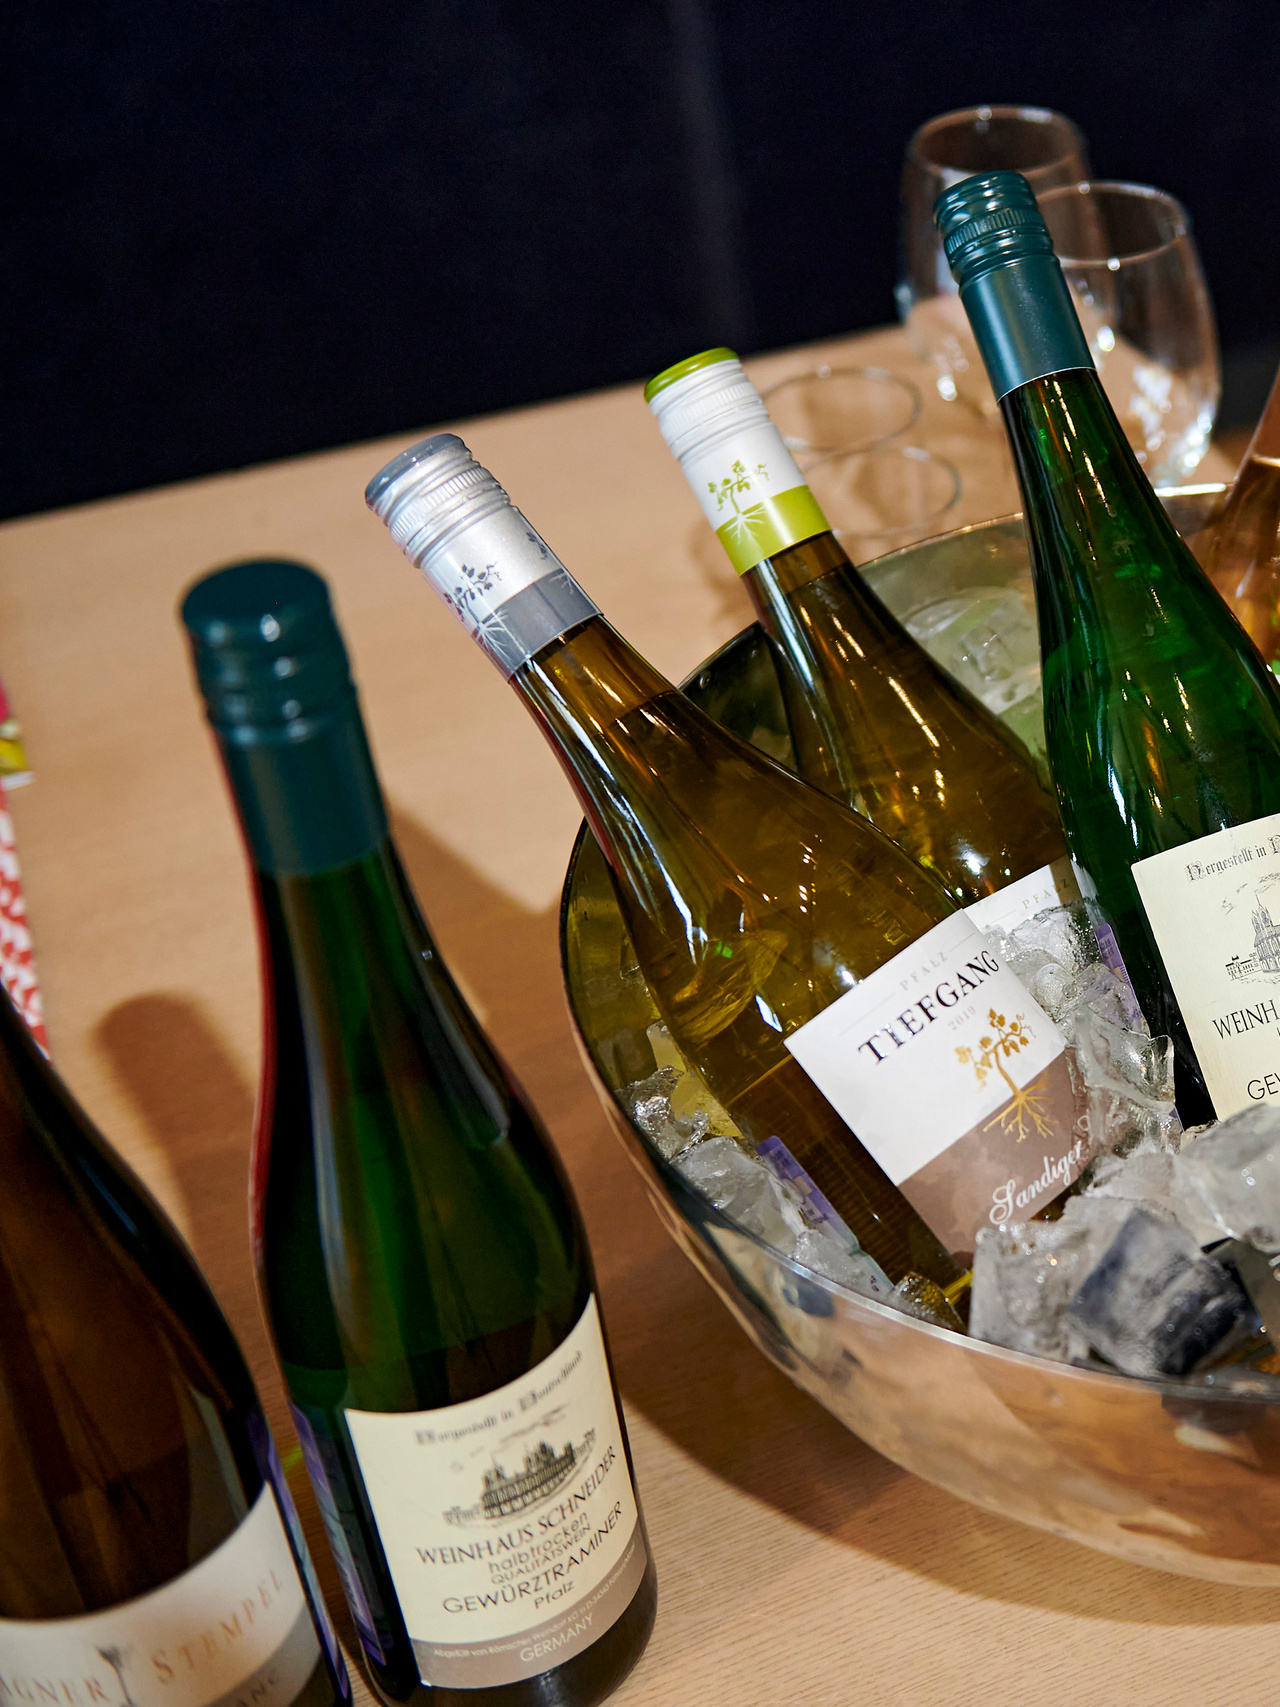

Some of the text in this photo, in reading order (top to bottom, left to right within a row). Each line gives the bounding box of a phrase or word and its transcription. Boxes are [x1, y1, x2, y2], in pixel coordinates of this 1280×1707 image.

[1185, 846, 1253, 881] Hergestellt
[1255, 844, 1267, 858] in
[900, 951, 948, 991] PFALZ
[858, 950, 999, 1065] TIEFGANG
[989, 1140, 1083, 1225] Sandiger
[416, 1445, 617, 1565] WEINHAUS SCHNEIDER
[442, 1500, 623, 1613] GEWÜRZTRAMINER
[487, 1511, 589, 1575] halbtrocken
[490, 1523, 591, 1585] QUALITÄTSWEIN
[151, 1567, 282, 1685] STEMPEL
[533, 1580, 575, 1610] Pfalz
[519, 1613, 593, 1663] GERMANY
